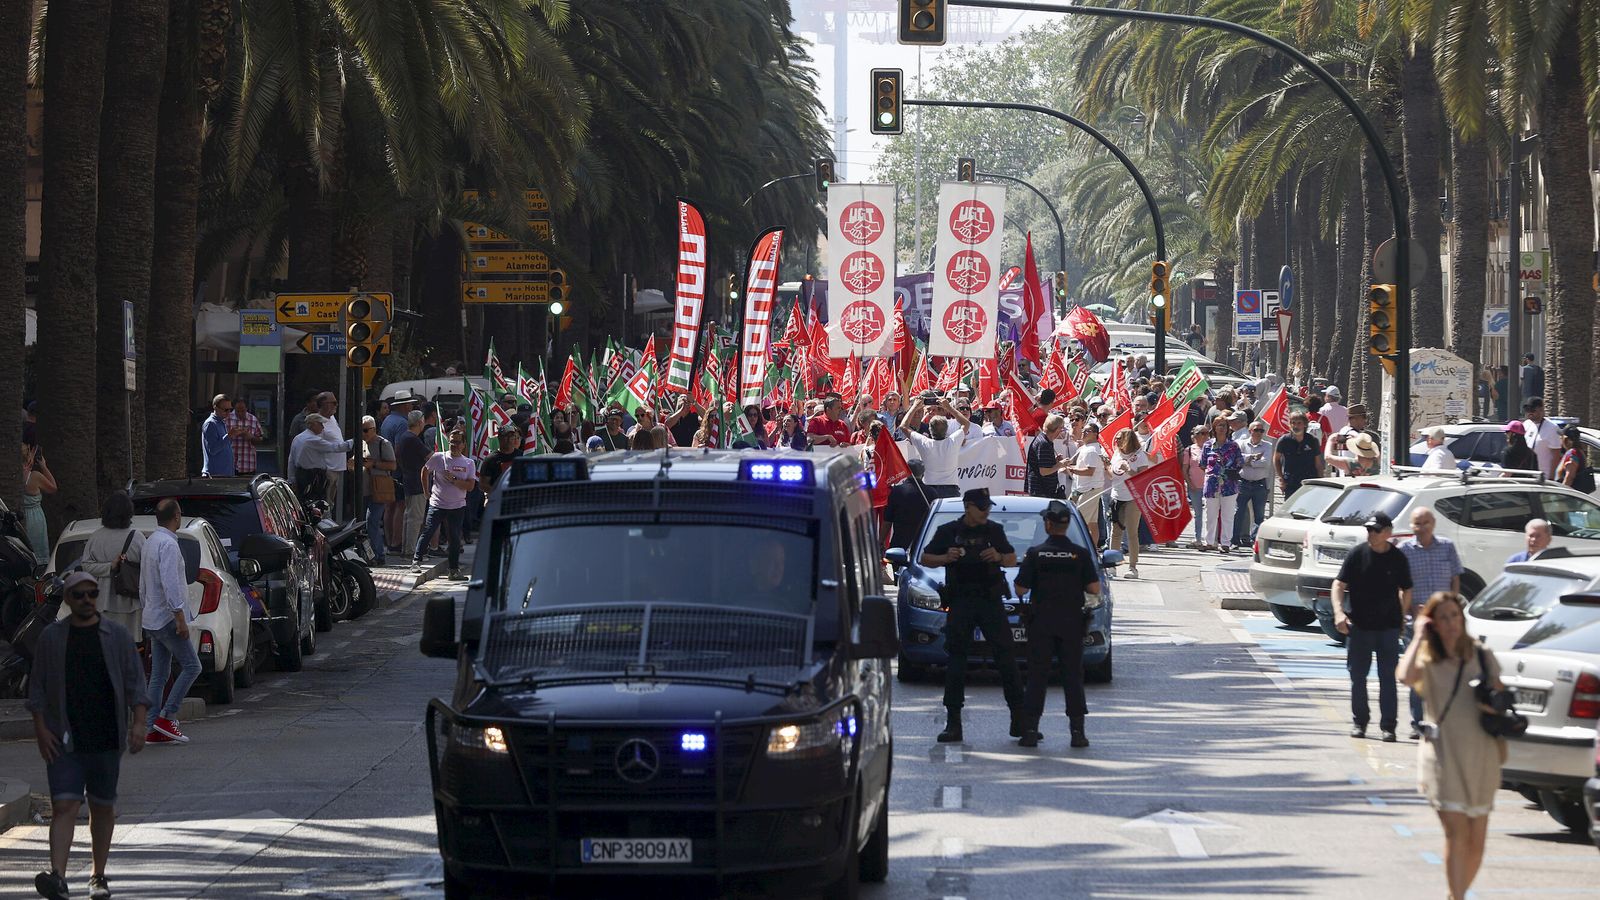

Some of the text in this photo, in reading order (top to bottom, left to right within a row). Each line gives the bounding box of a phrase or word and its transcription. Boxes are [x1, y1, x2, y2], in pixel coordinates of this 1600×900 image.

[849, 207, 875, 223] UGT
[959, 206, 986, 222] UGT
[506, 262, 547, 271] Alameda
[849, 257, 875, 272] UGT
[956, 256, 981, 272] UGT
[525, 284, 547, 292] Hotel
[505, 293, 547, 302] Mariposa
[850, 306, 875, 321] UGT
[952, 306, 978, 322] UGT
[1009, 467, 1026, 479] UG
[1157, 481, 1182, 511] UGT
